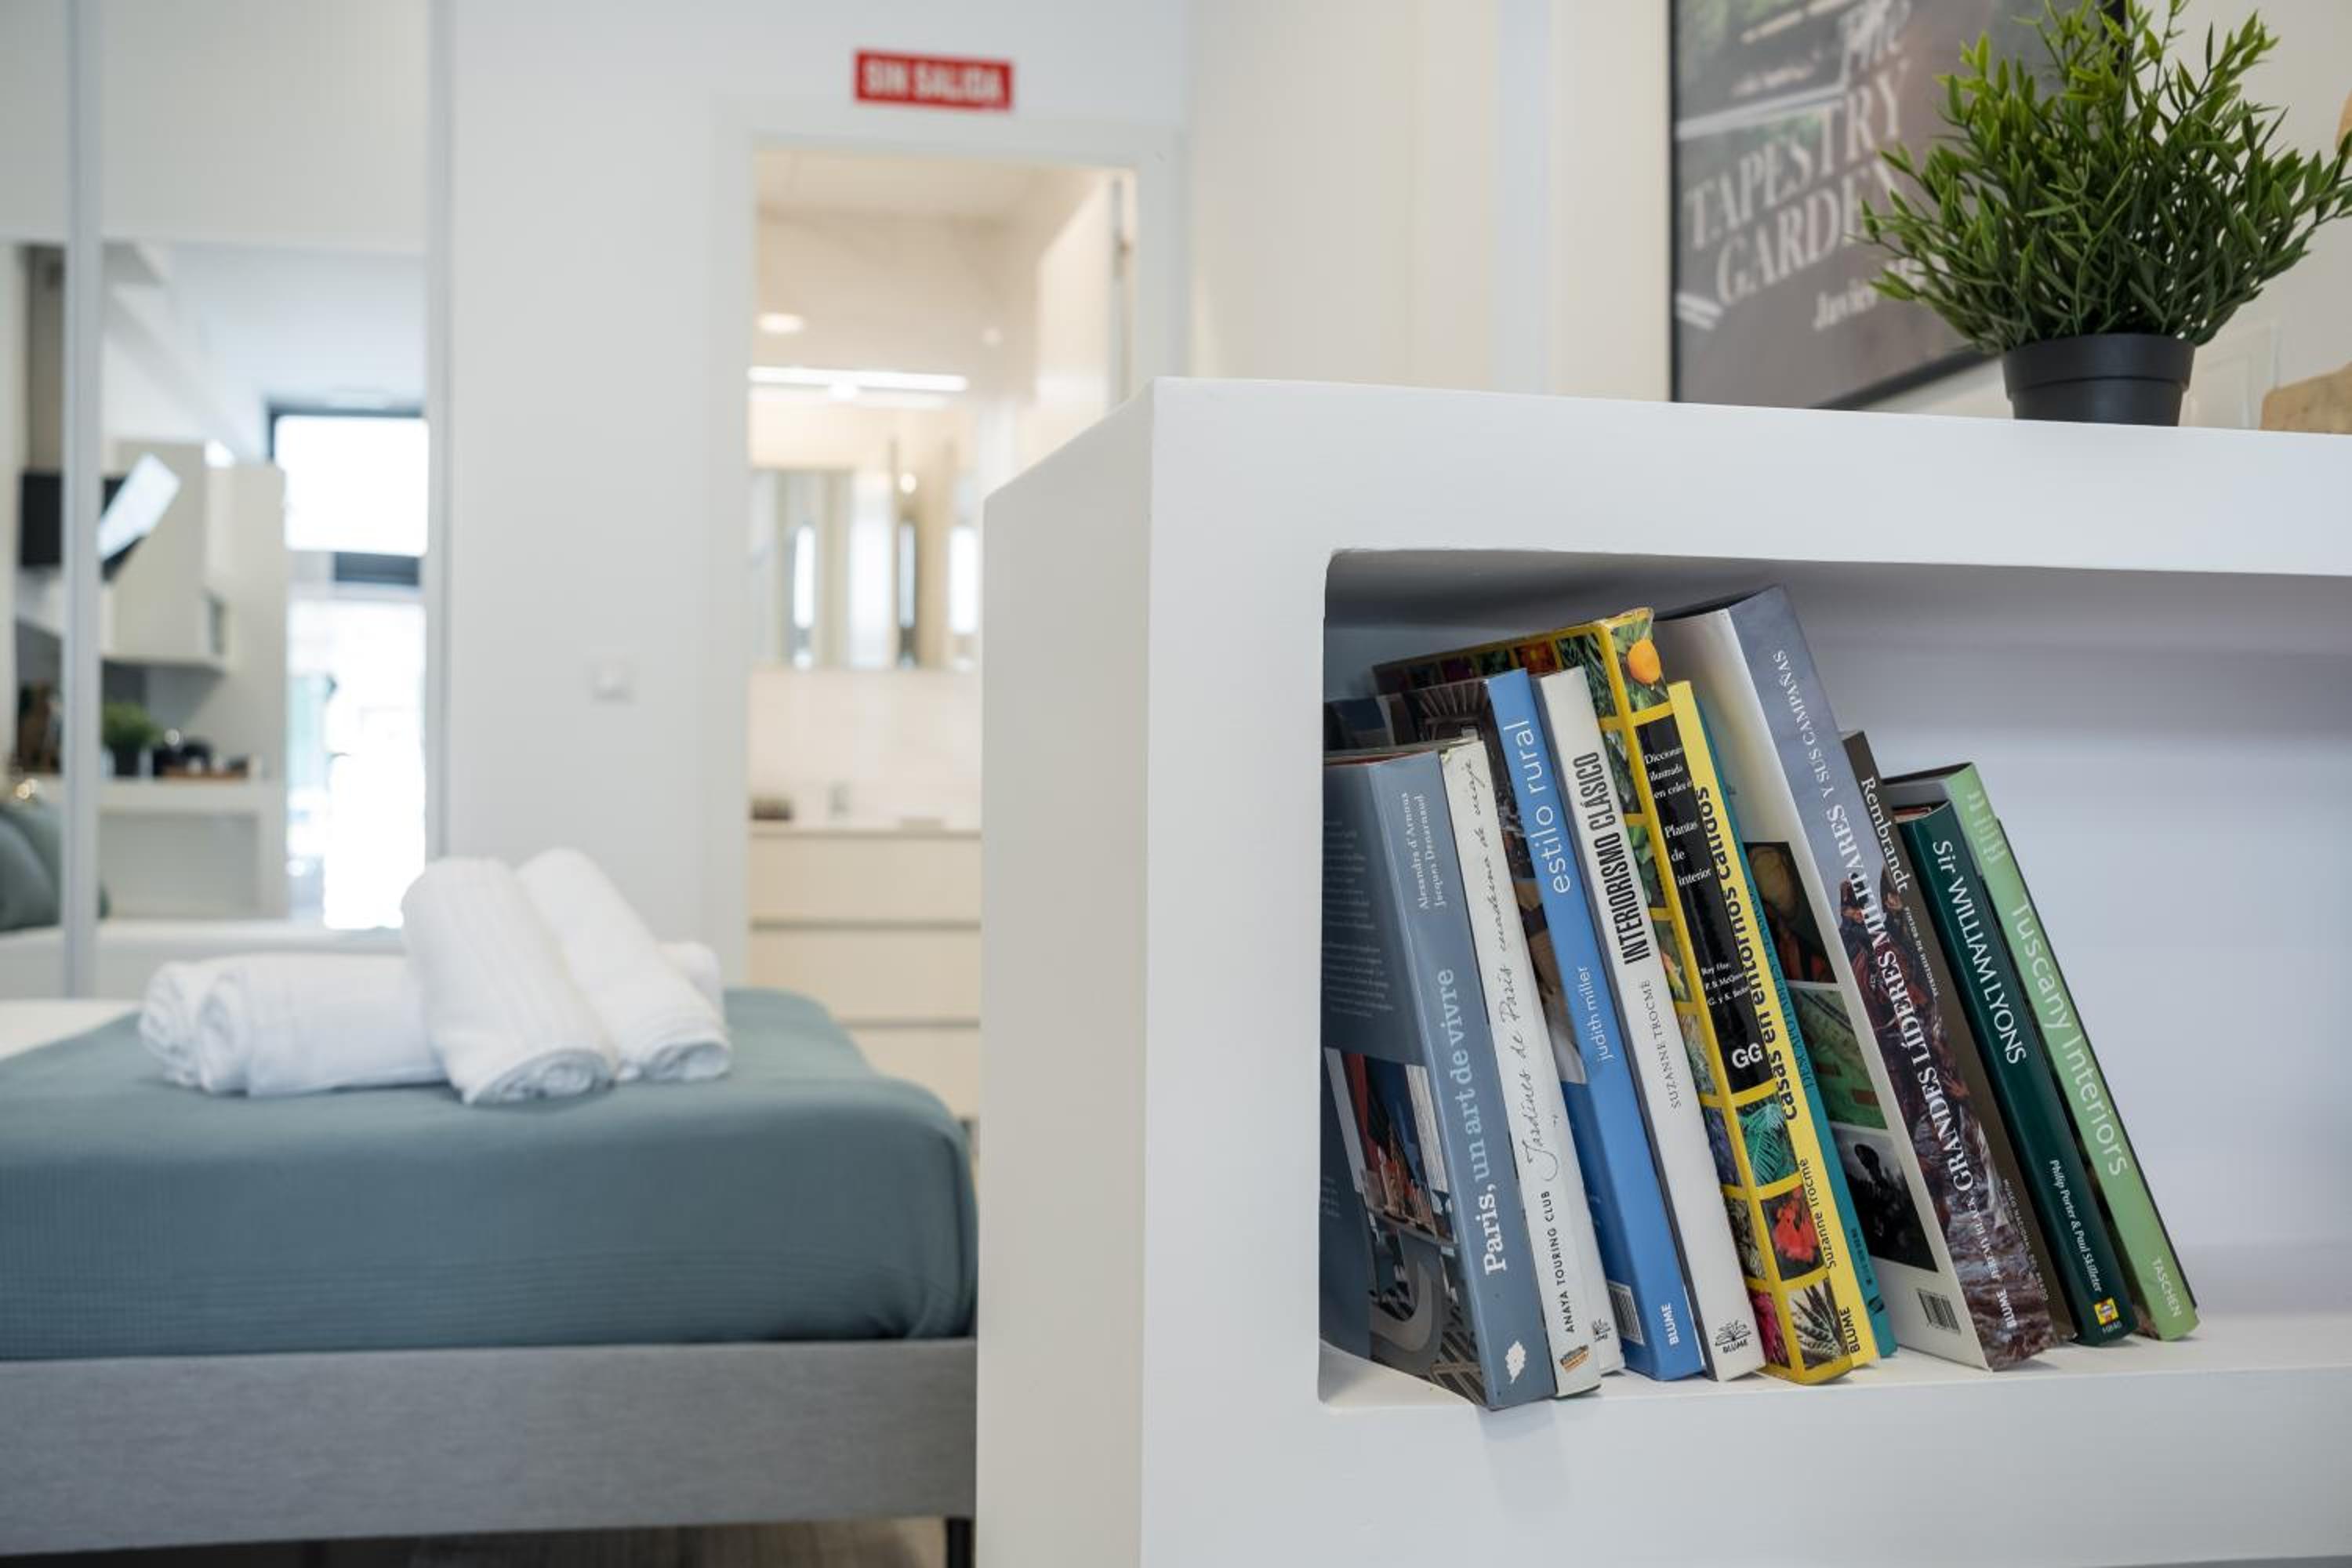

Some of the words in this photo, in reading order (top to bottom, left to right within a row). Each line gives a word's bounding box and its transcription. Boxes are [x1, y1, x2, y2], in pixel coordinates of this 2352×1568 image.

[866, 60, 906, 96] SIN
[915, 63, 1002, 102] SALIDA
[1686, 72, 1900, 251] TAPESTRY
[1772, 649, 1817, 746] CAMPAÑAS
[1503, 720, 1548, 794] rural
[1808, 745, 1831, 784] SUS
[1461, 758, 1486, 816] viaje
[1572, 751, 1617, 831] CLÁSICO
[1820, 785, 1835, 800] Y
[1474, 827, 1489, 848] de
[1530, 805, 1570, 894] estilo
[1664, 820, 1700, 839] Plantas
[1860, 776, 1911, 894] Rembrandt
[1671, 848, 1686, 862] de
[1677, 866, 1713, 887] interior
[1825, 804, 1892, 951] MILITARES
[1592, 832, 1652, 965] INTERIORISMO
[1725, 887, 1766, 1006] entornos
[1903, 906, 1920, 941] PINTOR
[1932, 839, 1957, 873] Sir
[1947, 876, 1998, 984] WILLIAM
[1984, 982, 2027, 1065] LYONS
[1437, 968, 1465, 1044] vivre
[1577, 967, 1599, 1012] miller
[1878, 951, 1931, 1066] LÍDERES
[1509, 1033, 1528, 1058] de
[1587, 1012, 1613, 1062] judith
[1759, 1011, 1776, 1044] en
[2010, 895, 2073, 1031] Tuscany
[2061, 1033, 2130, 1176] Interiors
[1450, 1048, 1474, 1085] de
[1655, 1043, 1682, 1109] SUZANNE
[1731, 1042, 1764, 1069] GG
[1767, 1049, 1798, 1121] casas
[1455, 1088, 1482, 1134] art
[1518, 1072, 1559, 1182] Jardines
[1916, 1067, 1976, 1192] GRANDES
[1468, 1138, 1490, 1181] un
[1540, 1190, 1555, 1221] CLUB
[2059, 1186, 2077, 1220] Porter
[2070, 1218, 2082, 1232] &
[1475, 1183, 1508, 1276] Paris,
[1813, 1212, 1838, 1269] Suzanne
[2074, 1230, 2089, 1254] Paul
[1547, 1228, 1566, 1286] TOURING
[1557, 1290, 1576, 1334] ANAYA
[1996, 1289, 2018, 1330] BLUME
[2151, 1257, 2183, 1319] TASCHEN
[1661, 1301, 1680, 1347] BLUME
[1722, 1339, 1749, 1355] BLUME
[1838, 1306, 1860, 1355] BLUME
